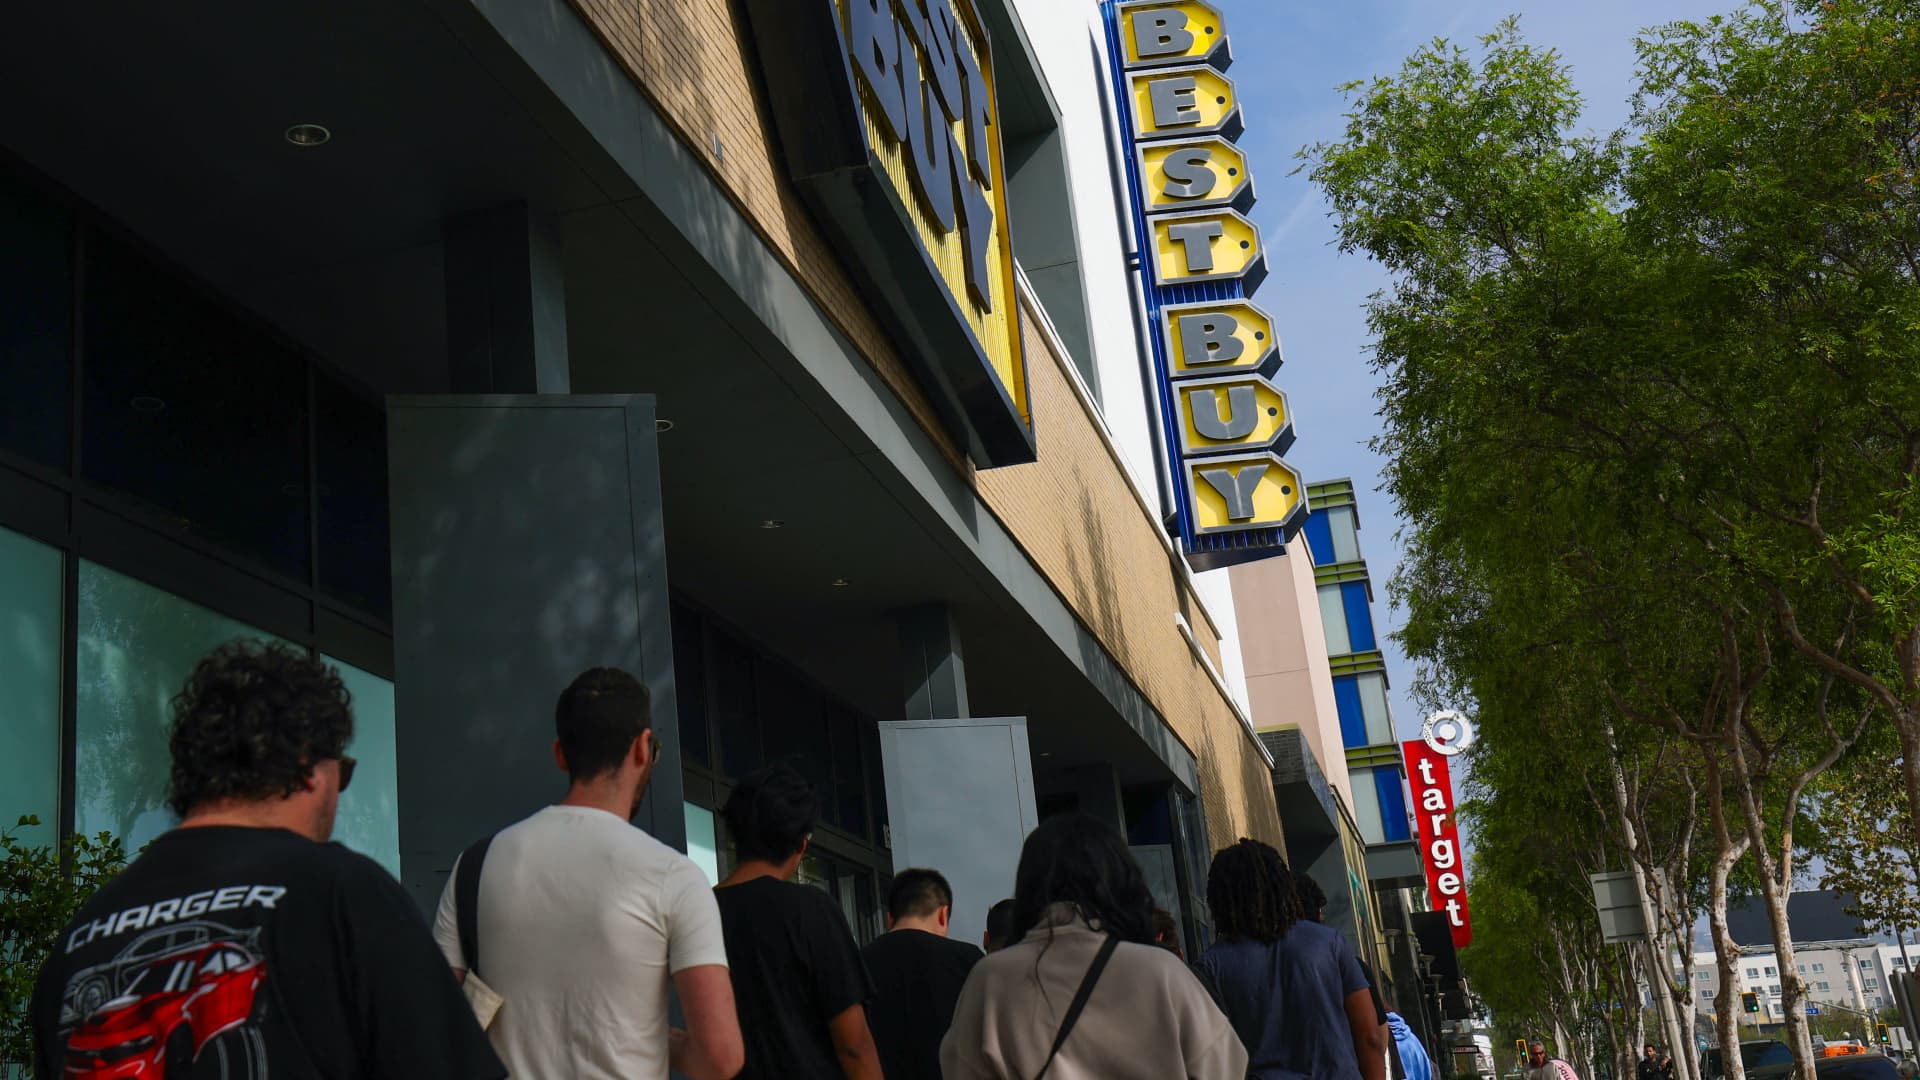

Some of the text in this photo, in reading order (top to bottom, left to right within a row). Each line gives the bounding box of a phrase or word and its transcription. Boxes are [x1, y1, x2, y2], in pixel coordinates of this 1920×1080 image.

[1132, 8, 1270, 520] BEST BUY
[64, 884, 288, 955] CHARGER
[1417, 757, 1464, 927] target
